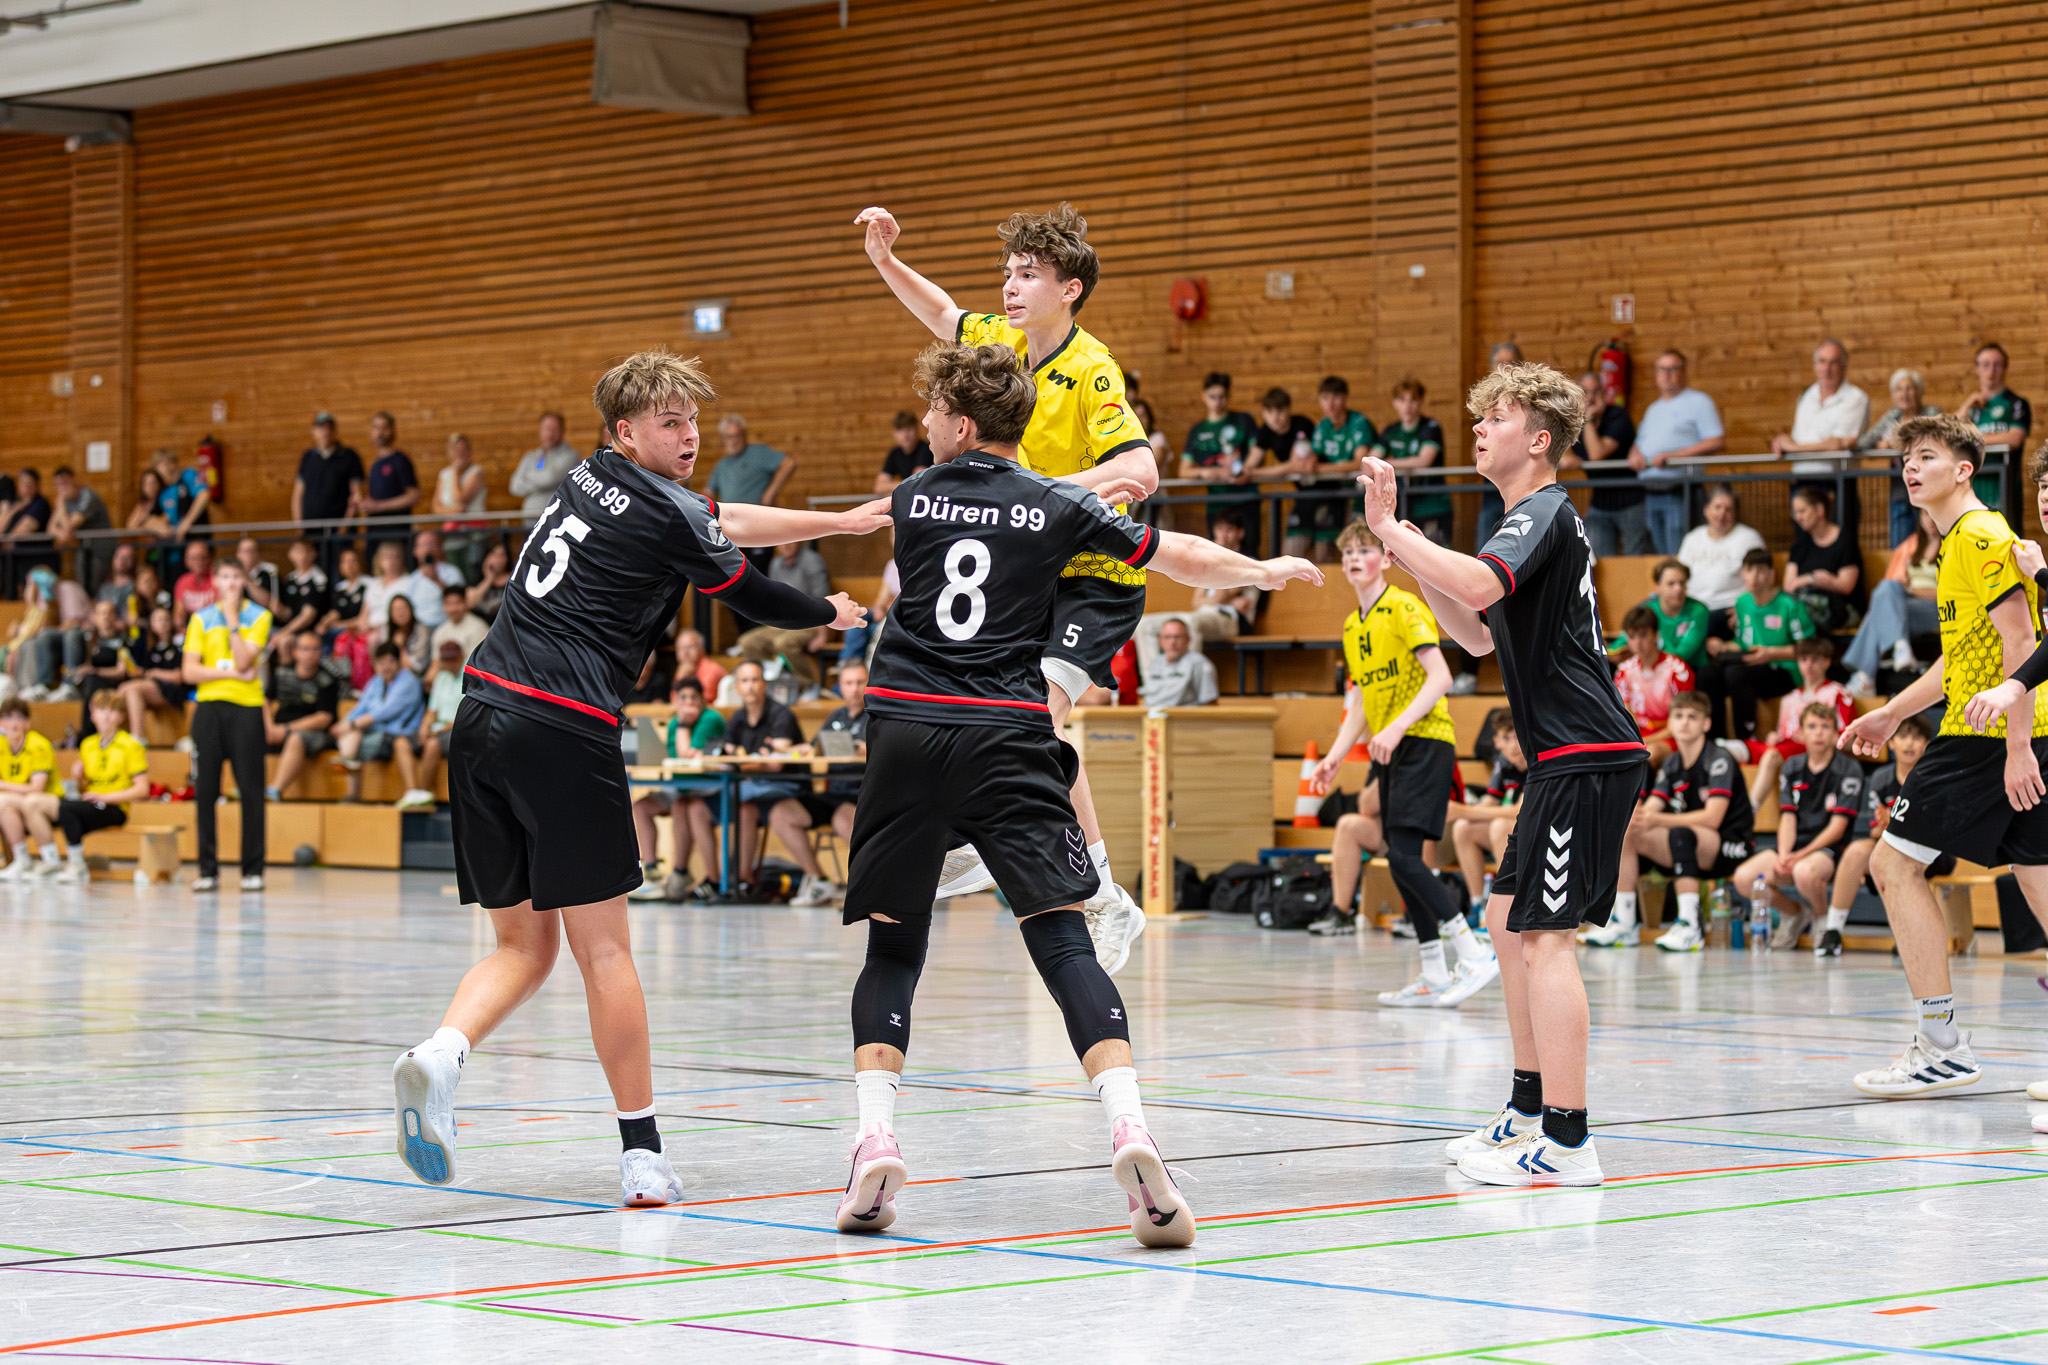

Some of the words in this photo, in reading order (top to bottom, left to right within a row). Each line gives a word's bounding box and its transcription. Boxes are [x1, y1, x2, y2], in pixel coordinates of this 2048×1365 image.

[599, 486, 631, 516] 99
[909, 494, 1000, 525] Düren
[1009, 504, 1046, 532] 99
[511, 498, 592, 599] 15
[935, 538, 992, 642] 8
[1062, 623, 1083, 648] 5
